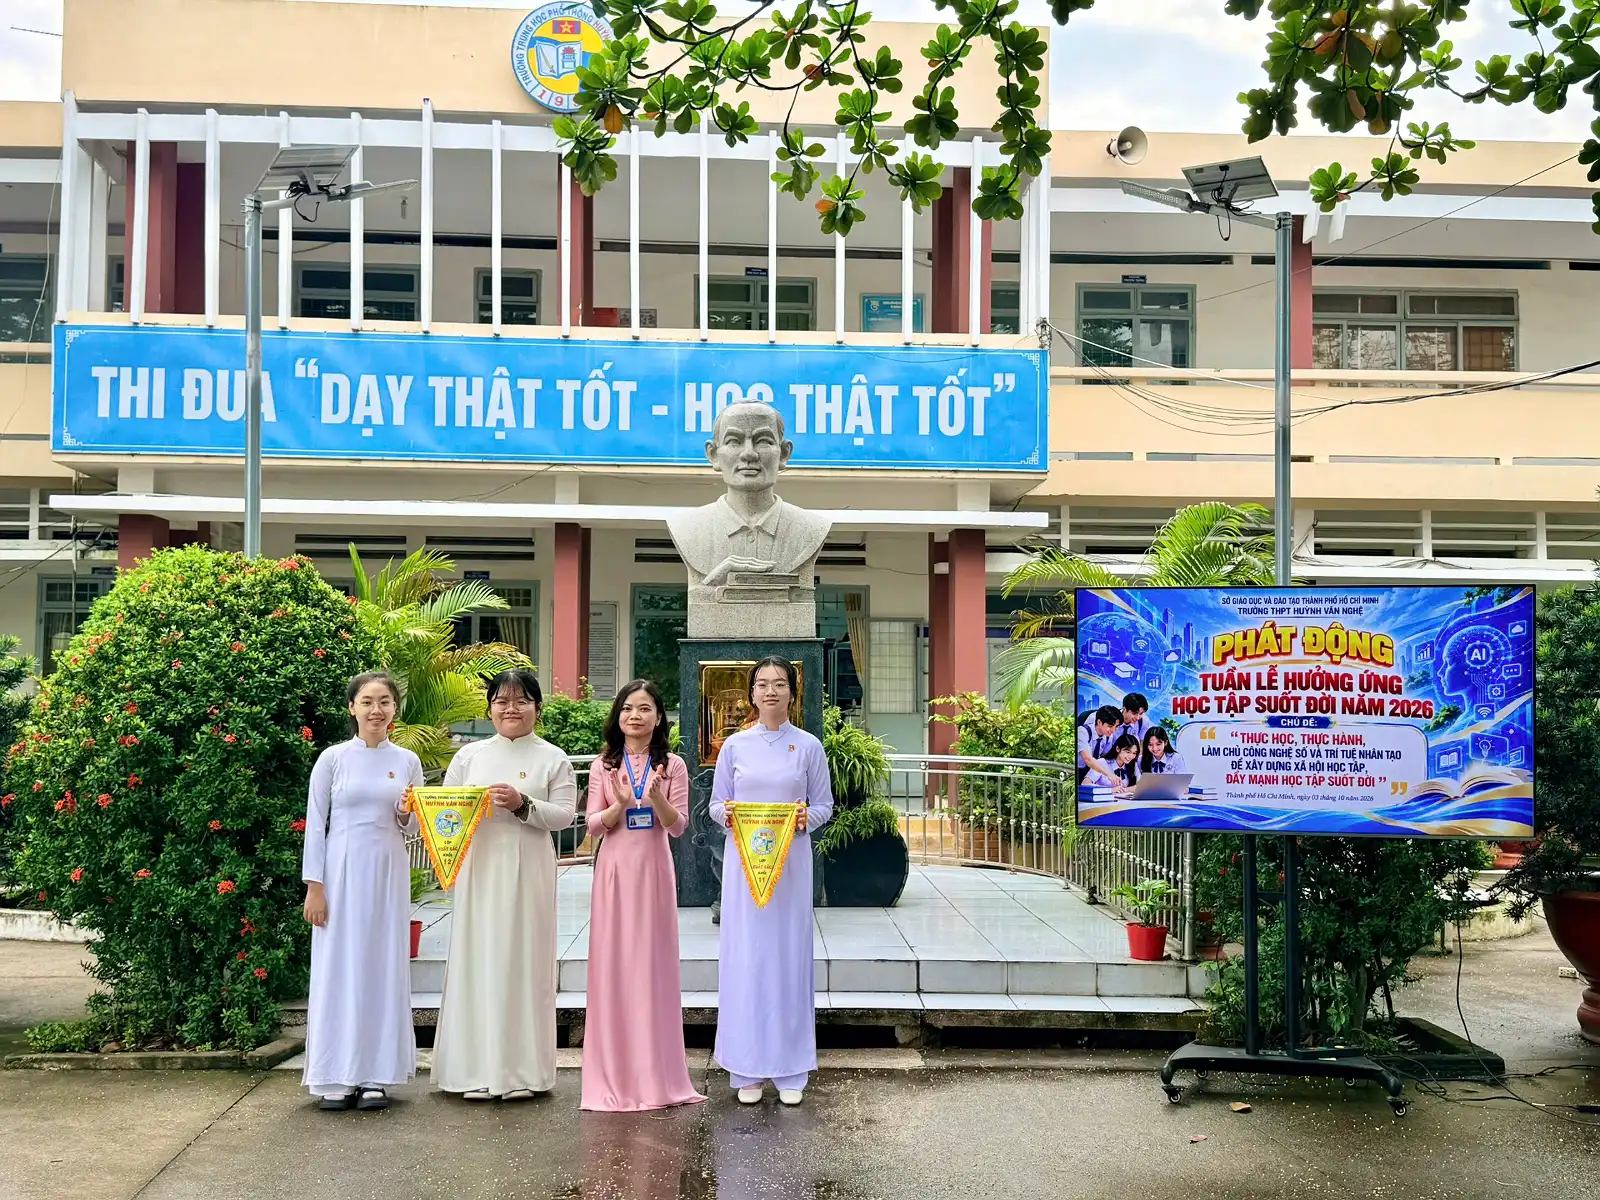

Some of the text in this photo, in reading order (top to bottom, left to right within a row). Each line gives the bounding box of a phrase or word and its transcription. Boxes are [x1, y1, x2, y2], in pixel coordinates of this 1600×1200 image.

[517, 25, 533, 51] TRUNG
[531, 12, 547, 28] HỌC
[91, 366, 164, 419] THI
[428, 366, 542, 440] THẬT
[556, 361, 638, 431] TỐT
[789, 373, 899, 446] THẬT
[1263, 596, 1272, 605] VÀ
[1362, 596, 1379, 605] MINH
[1237, 606, 1364, 617] TRƯỜNG THPT HUỲNH VĂN NGHỆ
[1212, 620, 1394, 667] PHÁT ĐỘNG
[1471, 648, 1486, 660] AI
[1199, 664, 1403, 695] TUẦN LỄ HƯỞNG ỨNG
[1172, 691, 1433, 719] HỌC TẬP SUỐT ĐỜI NĂM 2026
[1280, 717, 1318, 726] CHỦ ĐỀ:
[1271, 733, 1297, 746] HỌC,
[1300, 733, 1329, 746] THỰC
[1332, 732, 1366, 747] HÀNH,
[1201, 745, 1402, 762] LÀM CHỦ CÔNG NGHỆ SỐ VÀ TRÍ TUỆ NHÂN TẠO
[1231, 757, 1368, 774] ĐỂ XÂY DỰNG XÃ HỘI HỌC TẬP,
[1226, 770, 1245, 784] ĐẨY
[1248, 774, 1278, 787] MẠNH
[1282, 775, 1302, 787] HỌC
[1305, 774, 1325, 788] TẬP
[1328, 773, 1355, 787] SUỐT
